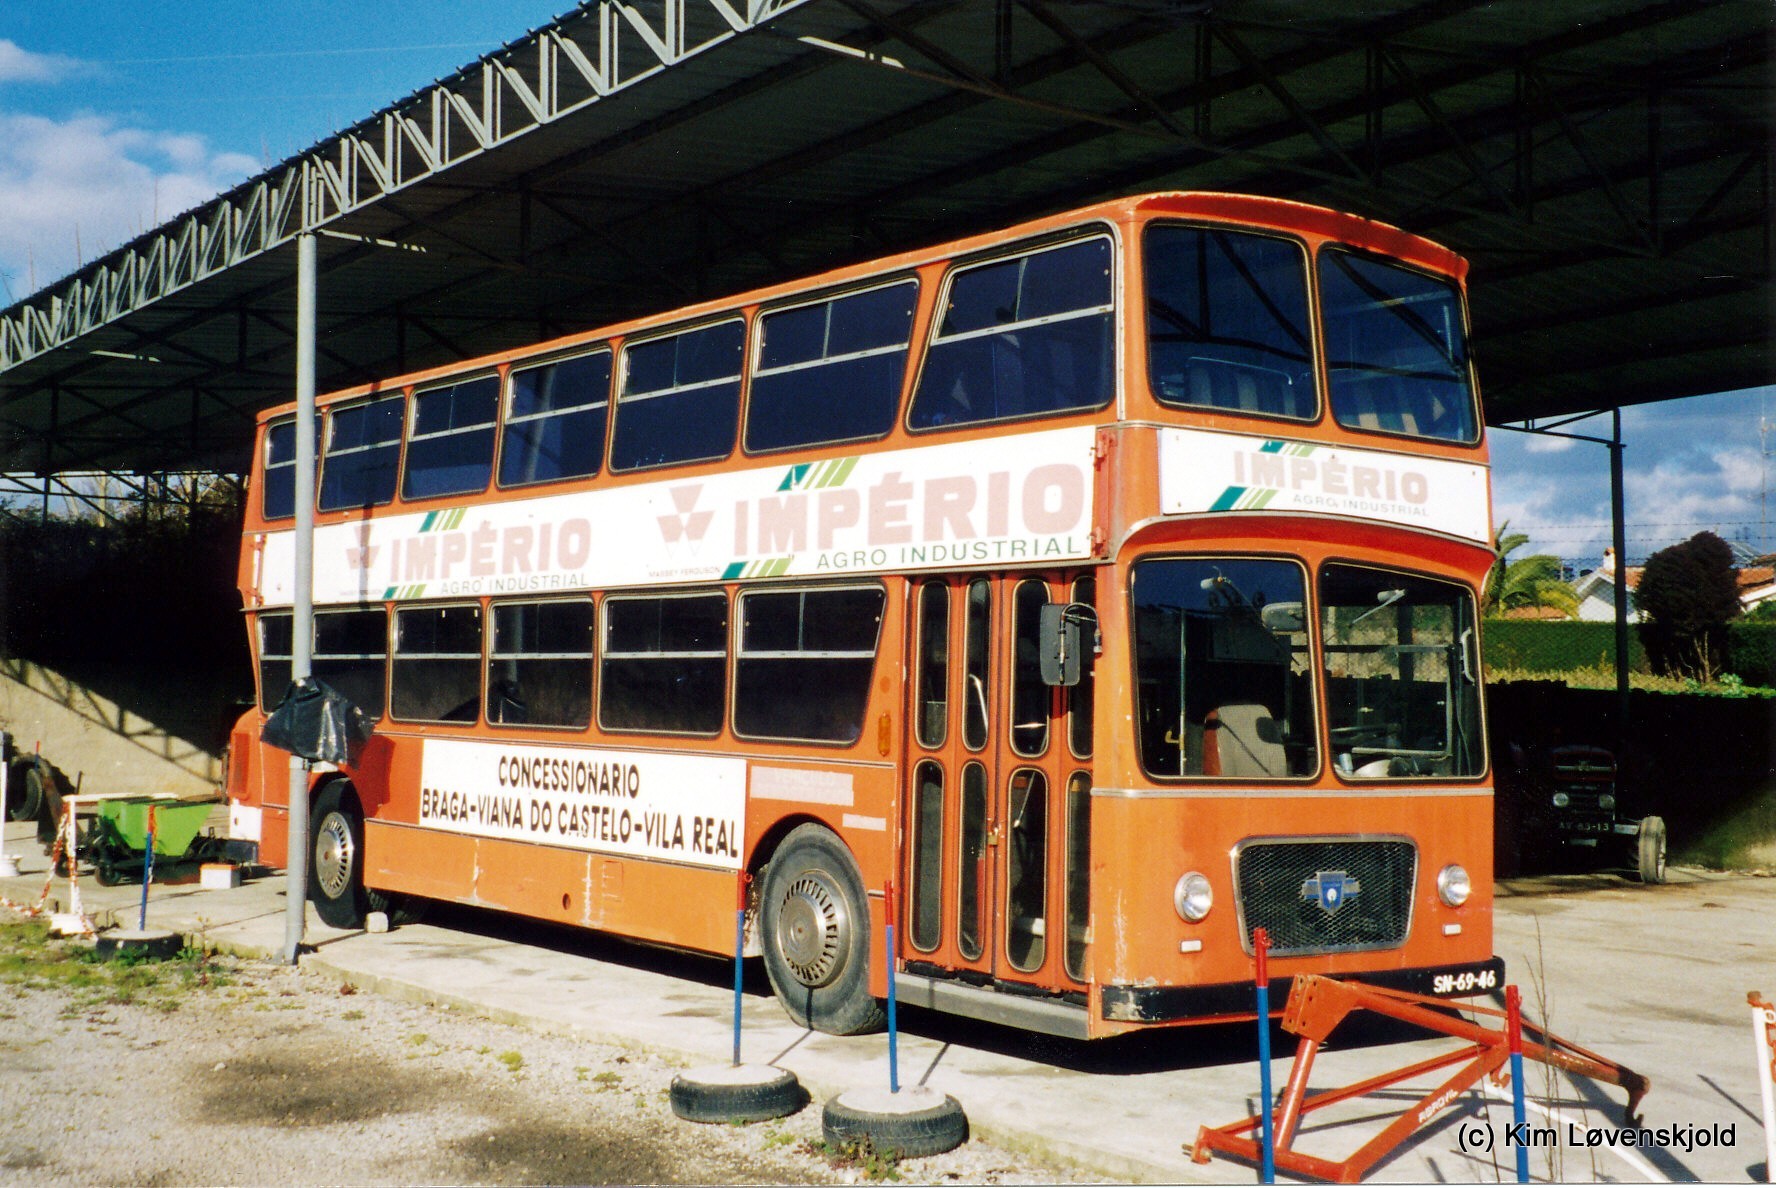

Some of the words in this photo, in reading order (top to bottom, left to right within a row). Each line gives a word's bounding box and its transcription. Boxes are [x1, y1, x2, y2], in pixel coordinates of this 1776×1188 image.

[1233, 450, 1429, 504] IMPÉRIO
[733, 463, 1085, 557] IMPÉRIO
[1293, 494, 1338, 508] AGRO
[1342, 499, 1430, 518] INDUSTRIAL
[390, 518, 592, 582] IMPÉRIO
[816, 548, 888, 570] AGRO
[901, 536, 1083, 565] INDUSTRIAL
[441, 578, 482, 594] AGRO
[486, 574, 589, 593] INDUSTRIAL
[498, 755, 640, 799] CONCESSIONARIO
[421, 788, 524, 830] BRAGA-VIANA
[531, 799, 552, 833] DO
[558, 802, 685, 851] CASTELO-VILA
[693, 816, 738, 858] REAL
[1433, 970, 1496, 993] SN-69-46
